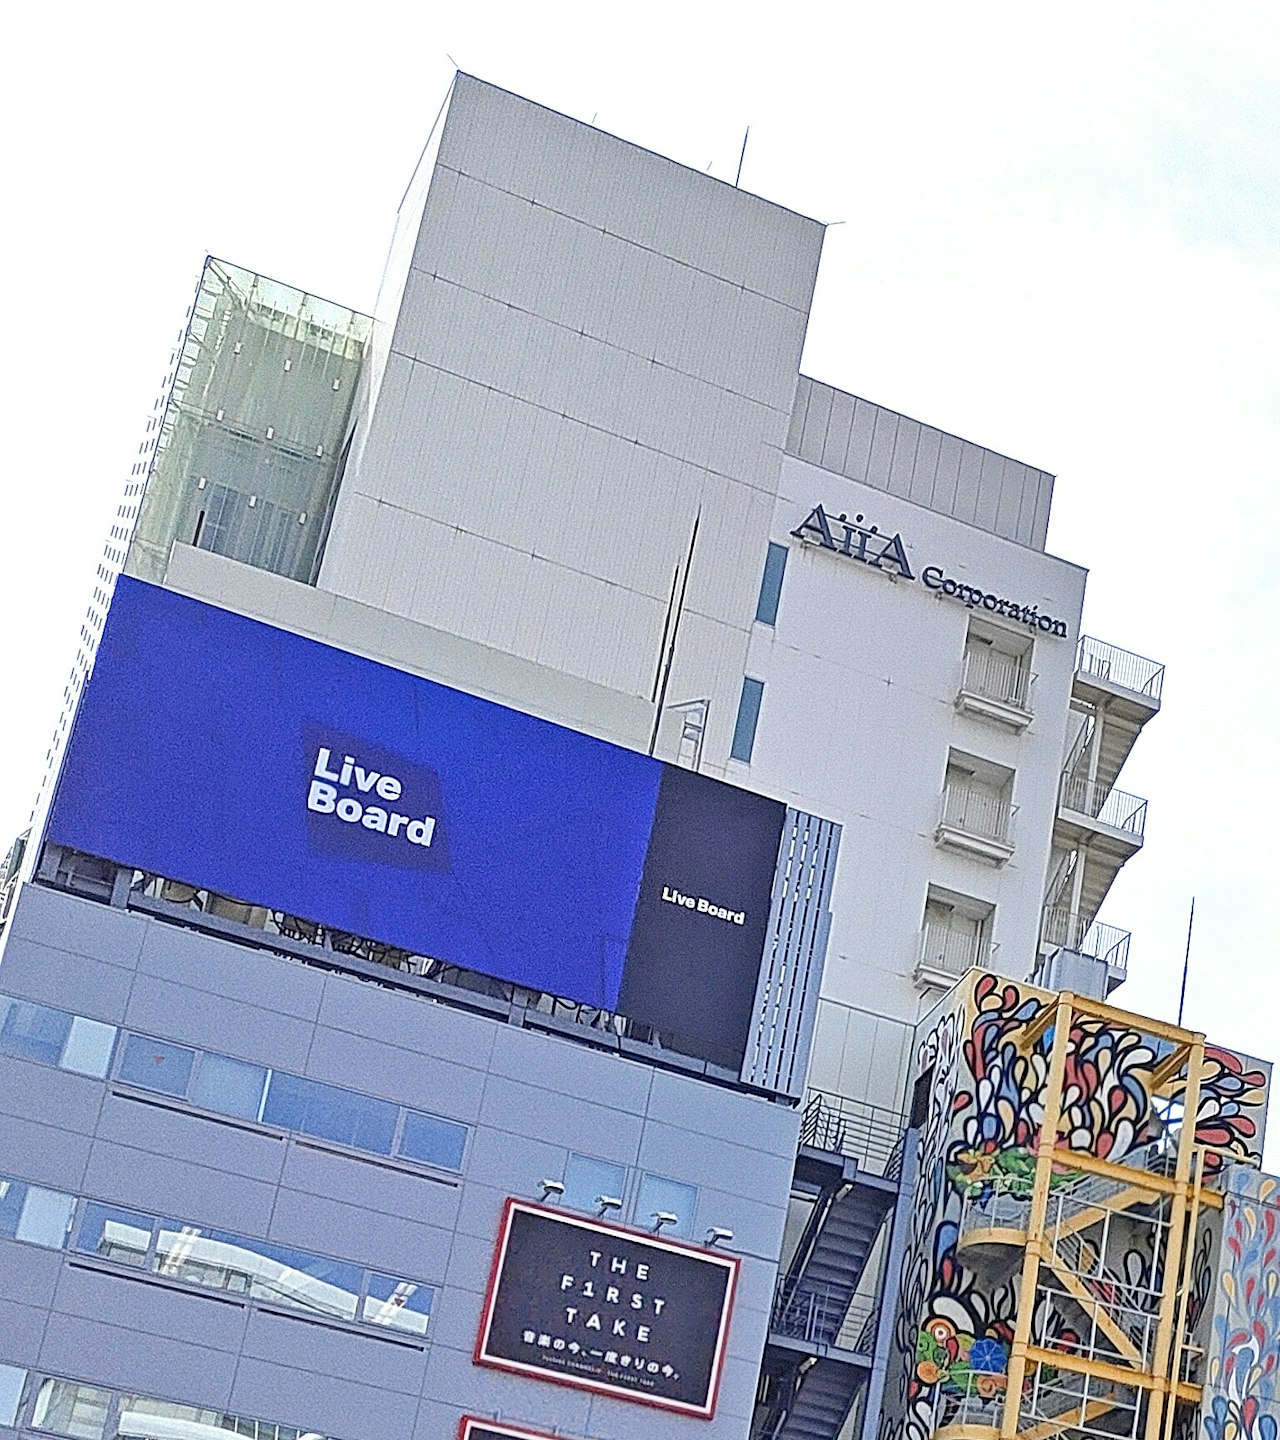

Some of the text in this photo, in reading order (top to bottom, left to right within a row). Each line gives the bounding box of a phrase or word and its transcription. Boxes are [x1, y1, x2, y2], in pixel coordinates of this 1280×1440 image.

[922, 566, 1068, 638] Corporation
[313, 747, 402, 801] Live
[307, 780, 436, 847] Board
[661, 886, 746, 926] Live Board
[590, 1251, 650, 1281] THE
[561, 1274, 665, 1316] F1RST
[566, 1307, 651, 1343] TAKE
